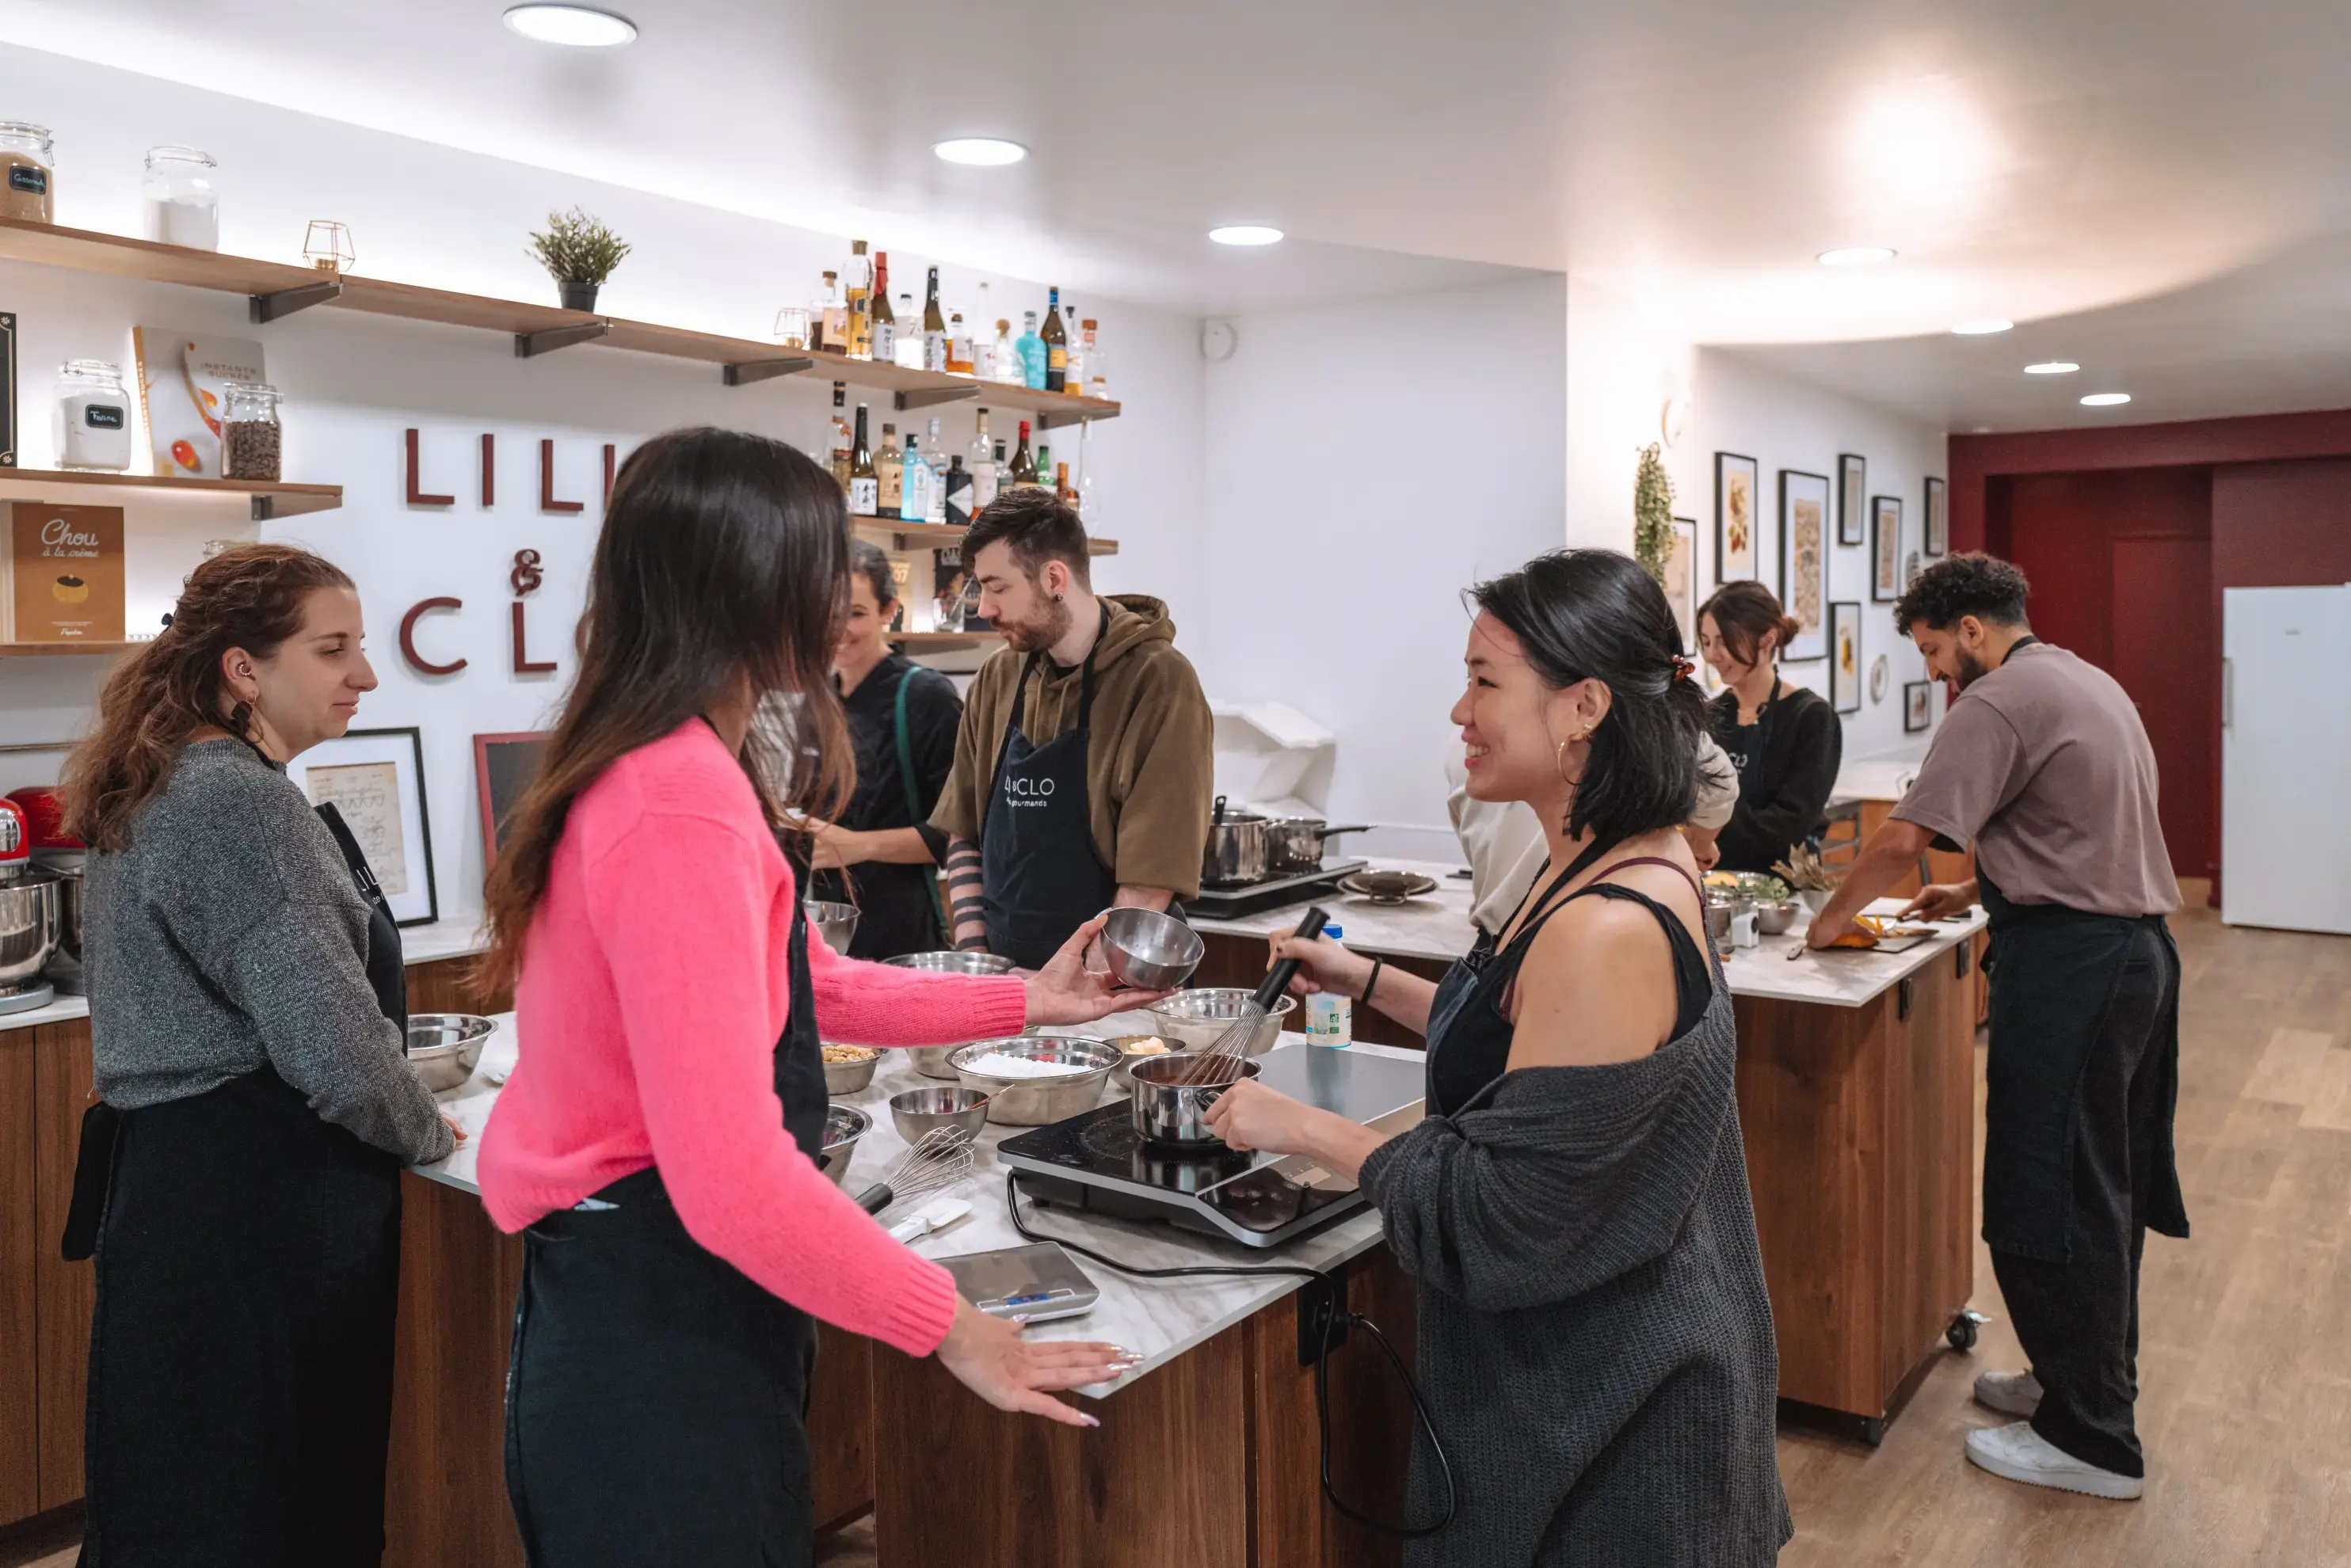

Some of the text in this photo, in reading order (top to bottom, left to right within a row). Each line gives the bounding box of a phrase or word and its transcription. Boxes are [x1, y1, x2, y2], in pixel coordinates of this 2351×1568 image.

[406, 428, 615, 513] LILI
[41, 519, 98, 546] Chou
[510, 549, 543, 596] &
[399, 596, 593, 675] CL
